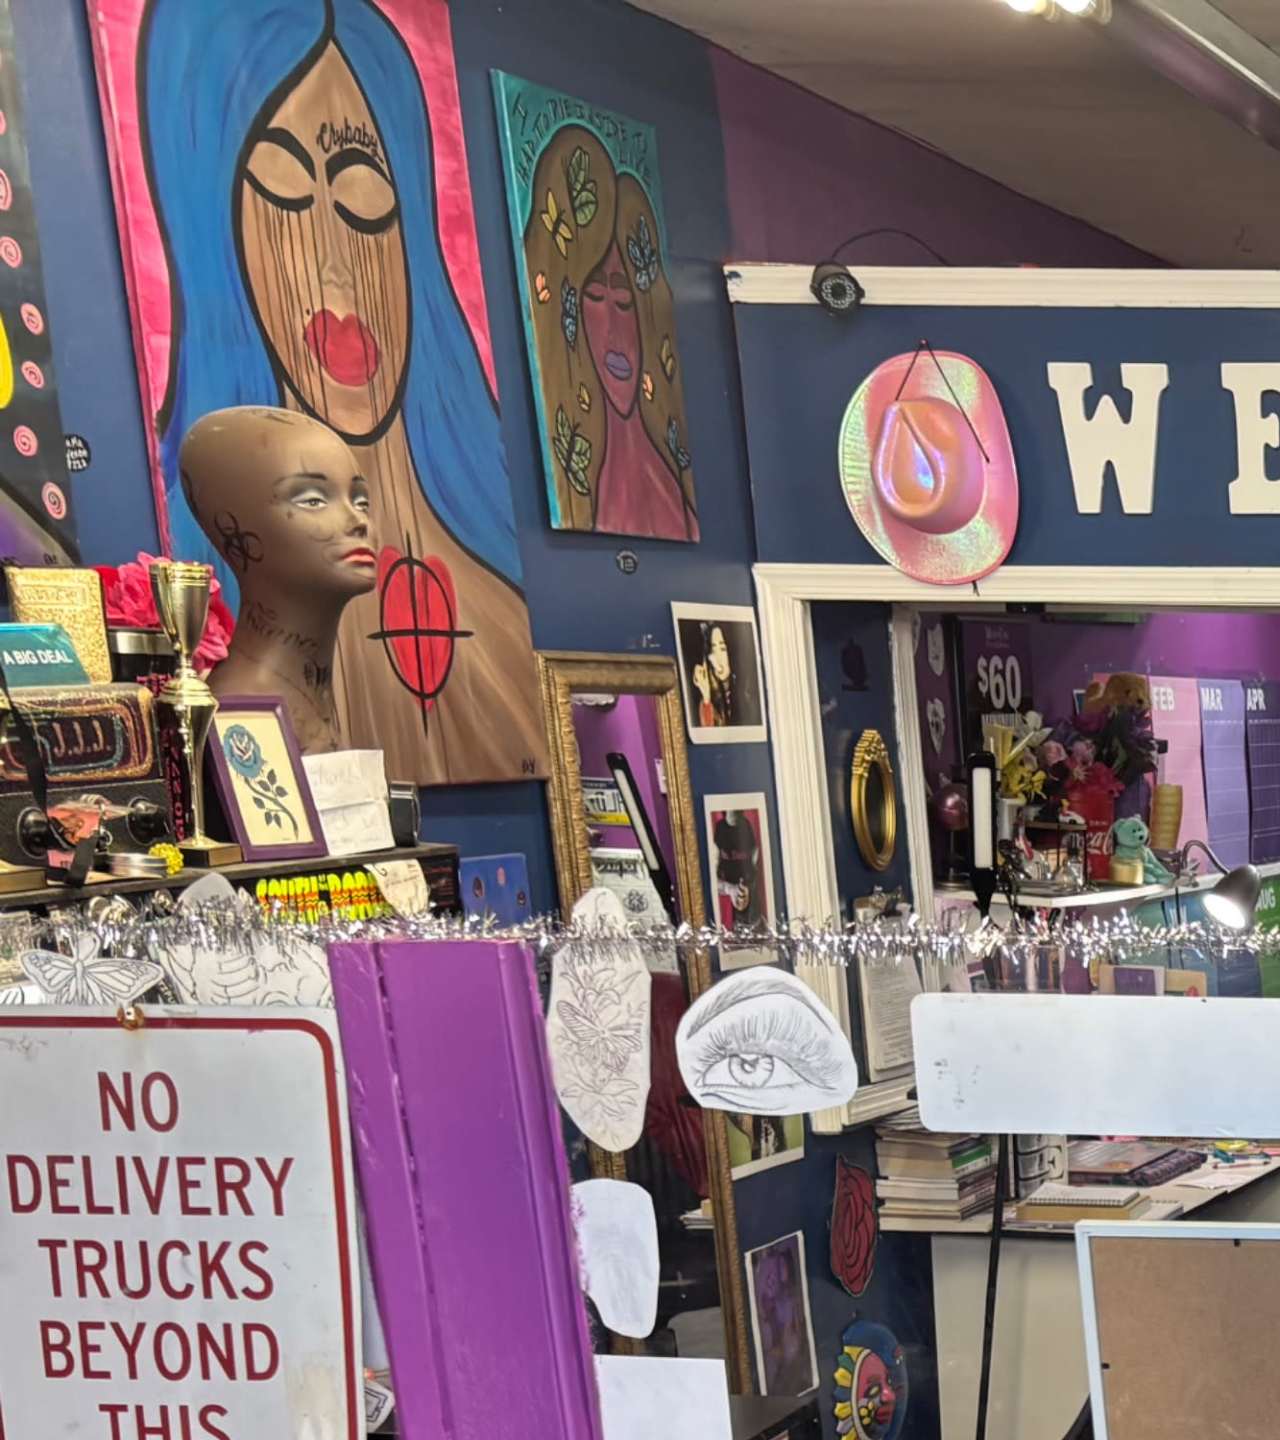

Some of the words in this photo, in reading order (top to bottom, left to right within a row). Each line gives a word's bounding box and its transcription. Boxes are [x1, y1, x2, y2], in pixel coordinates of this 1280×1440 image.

[316, 121, 383, 164] Crybaby
[18, 651, 39, 665] BIG
[40, 649, 73, 665] DEAL
[977, 655, 1021, 709] $60
[1152, 687, 1175, 711] FEB
[1201, 687, 1223, 712] MAR
[1247, 688, 1266, 711] APR
[98, 1070, 180, 1133] NO
[6, 1155, 295, 1217] DELIVERY
[37, 1238, 274, 1302] TRUCKS
[39, 1320, 280, 1382] BEYOND
